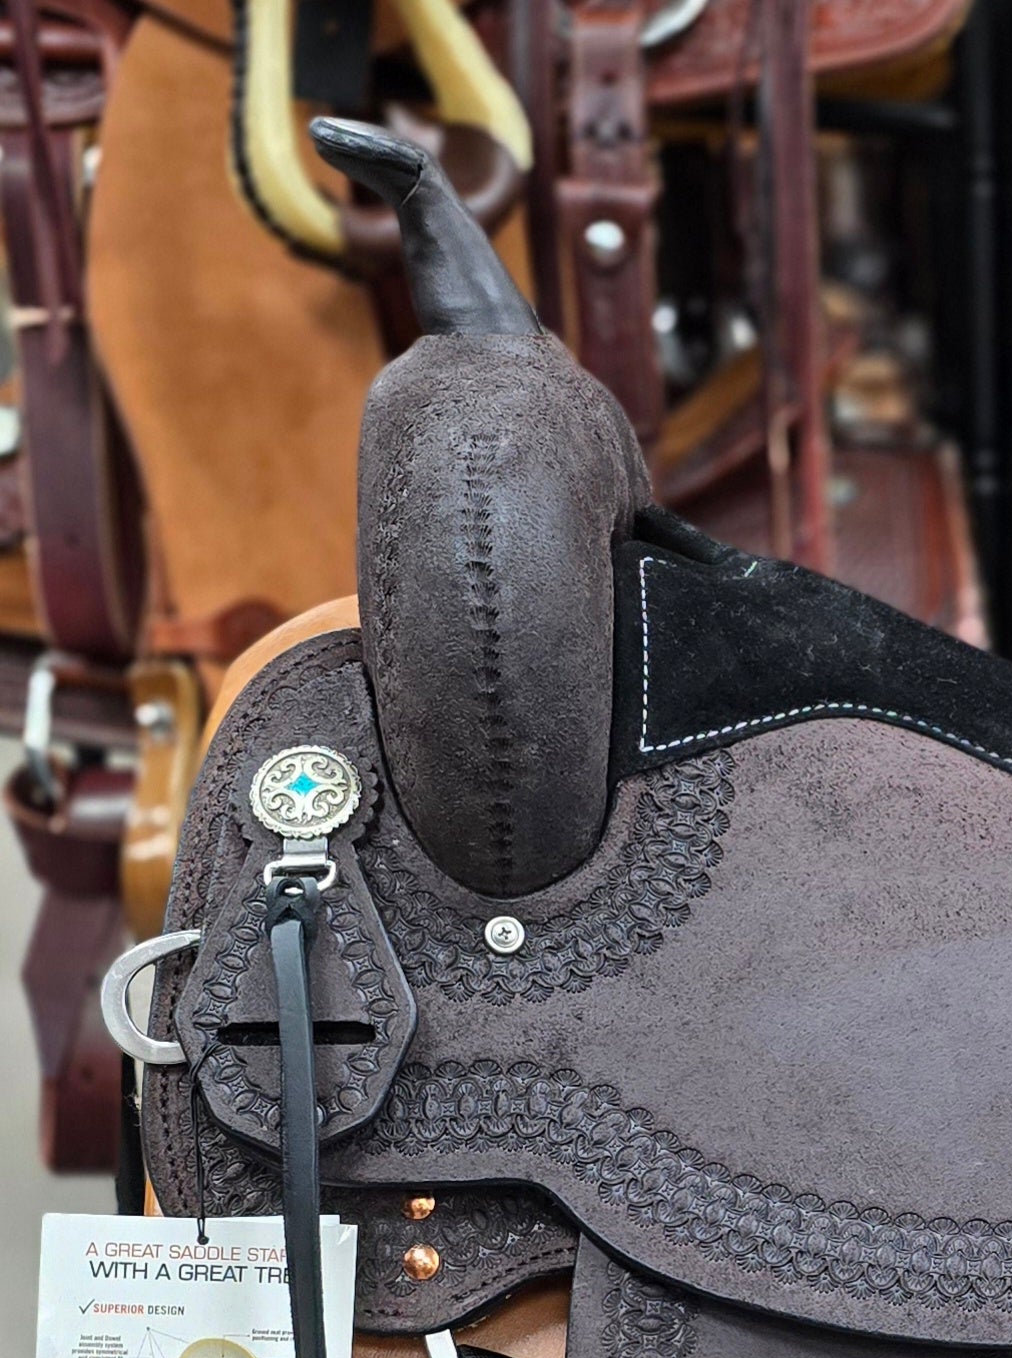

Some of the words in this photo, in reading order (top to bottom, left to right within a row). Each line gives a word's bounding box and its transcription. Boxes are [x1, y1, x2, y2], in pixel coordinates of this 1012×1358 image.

[86, 1242, 98, 1256] A
[105, 1243, 163, 1259] GREAT
[169, 1245, 240, 1261] SADDLE
[90, 1260, 148, 1279] WITH
[155, 1263, 171, 1280] A
[178, 1264, 248, 1282] GREAT
[93, 1303, 144, 1315] SUPERIOR
[148, 1305, 185, 1316] DESIGN
